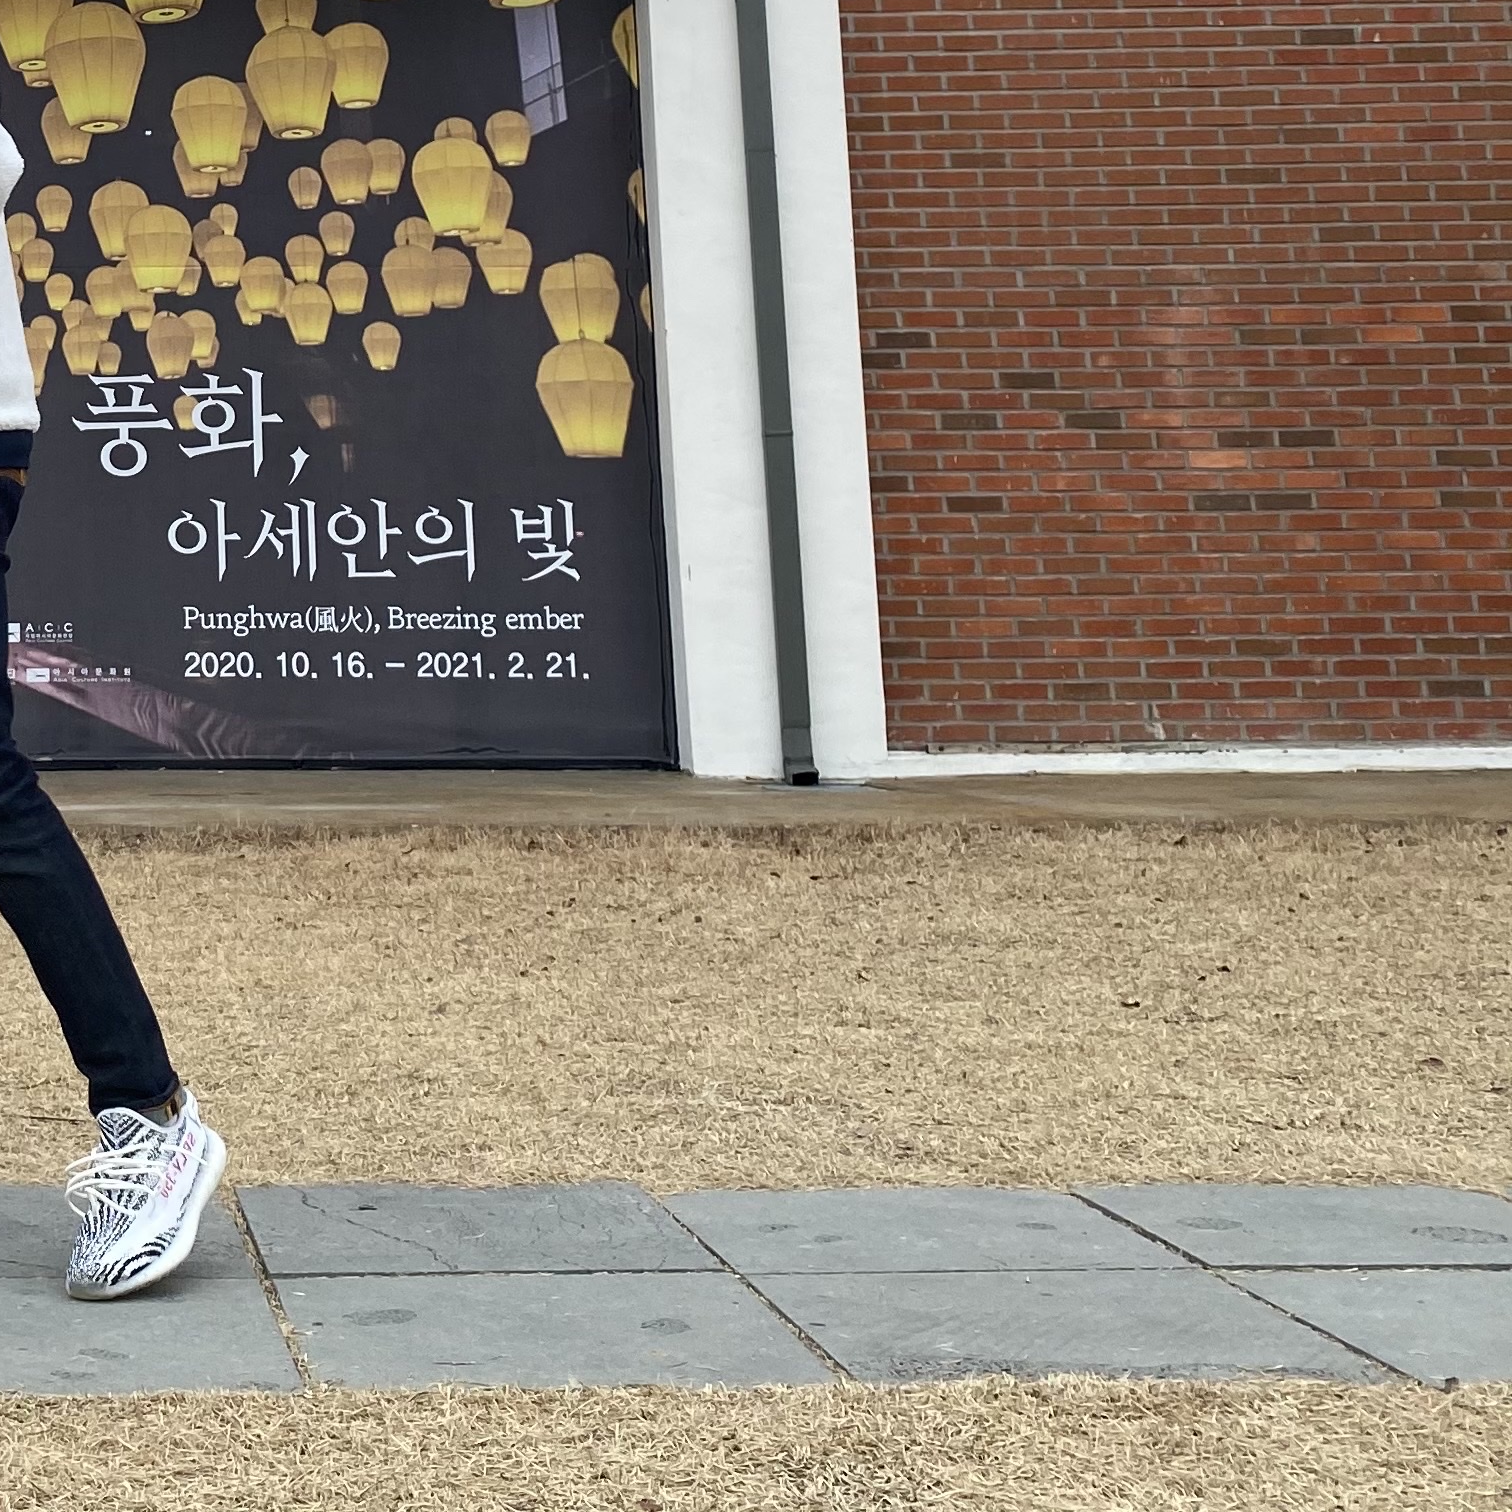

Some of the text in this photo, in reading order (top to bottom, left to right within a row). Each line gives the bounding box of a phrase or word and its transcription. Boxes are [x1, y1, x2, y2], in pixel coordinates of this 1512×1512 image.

[71, 367, 310, 486] 풍화,
[167, 498, 582, 583] 아세안의 빛
[182, 604, 585, 638] Punghwa(風火), Breezing ember
[184, 651, 262, 679] 2020.
[276, 651, 318, 679] 10.
[331, 651, 374, 679] 16.
[417, 651, 496, 680] 2021.
[507, 651, 534, 680] 2.
[545, 651, 590, 680] 21.
